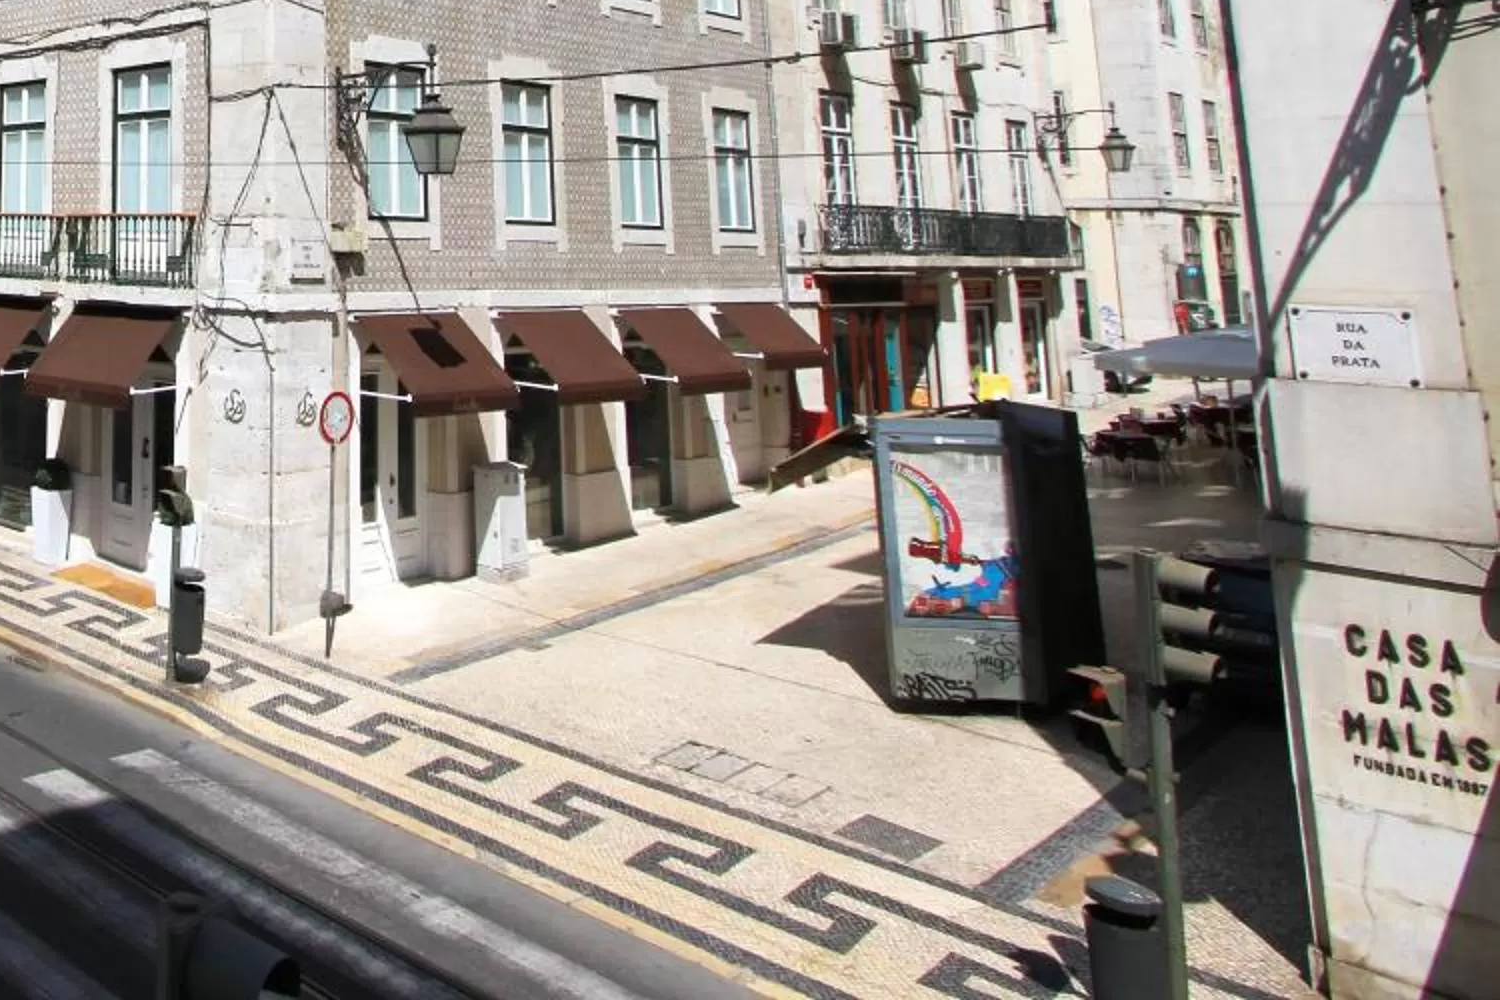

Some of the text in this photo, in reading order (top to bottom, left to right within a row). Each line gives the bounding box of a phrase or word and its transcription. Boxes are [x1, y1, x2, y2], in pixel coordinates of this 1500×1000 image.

[1335, 322, 1368, 334] RUA
[1343, 339, 1365, 351] DA
[1331, 355, 1381, 369] PRATA
[1344, 623, 1465, 676] CASA
[1365, 668, 1454, 718] DAS
[1342, 709, 1493, 773] MALAS
[1353, 754, 1428, 785] FUNDADA
